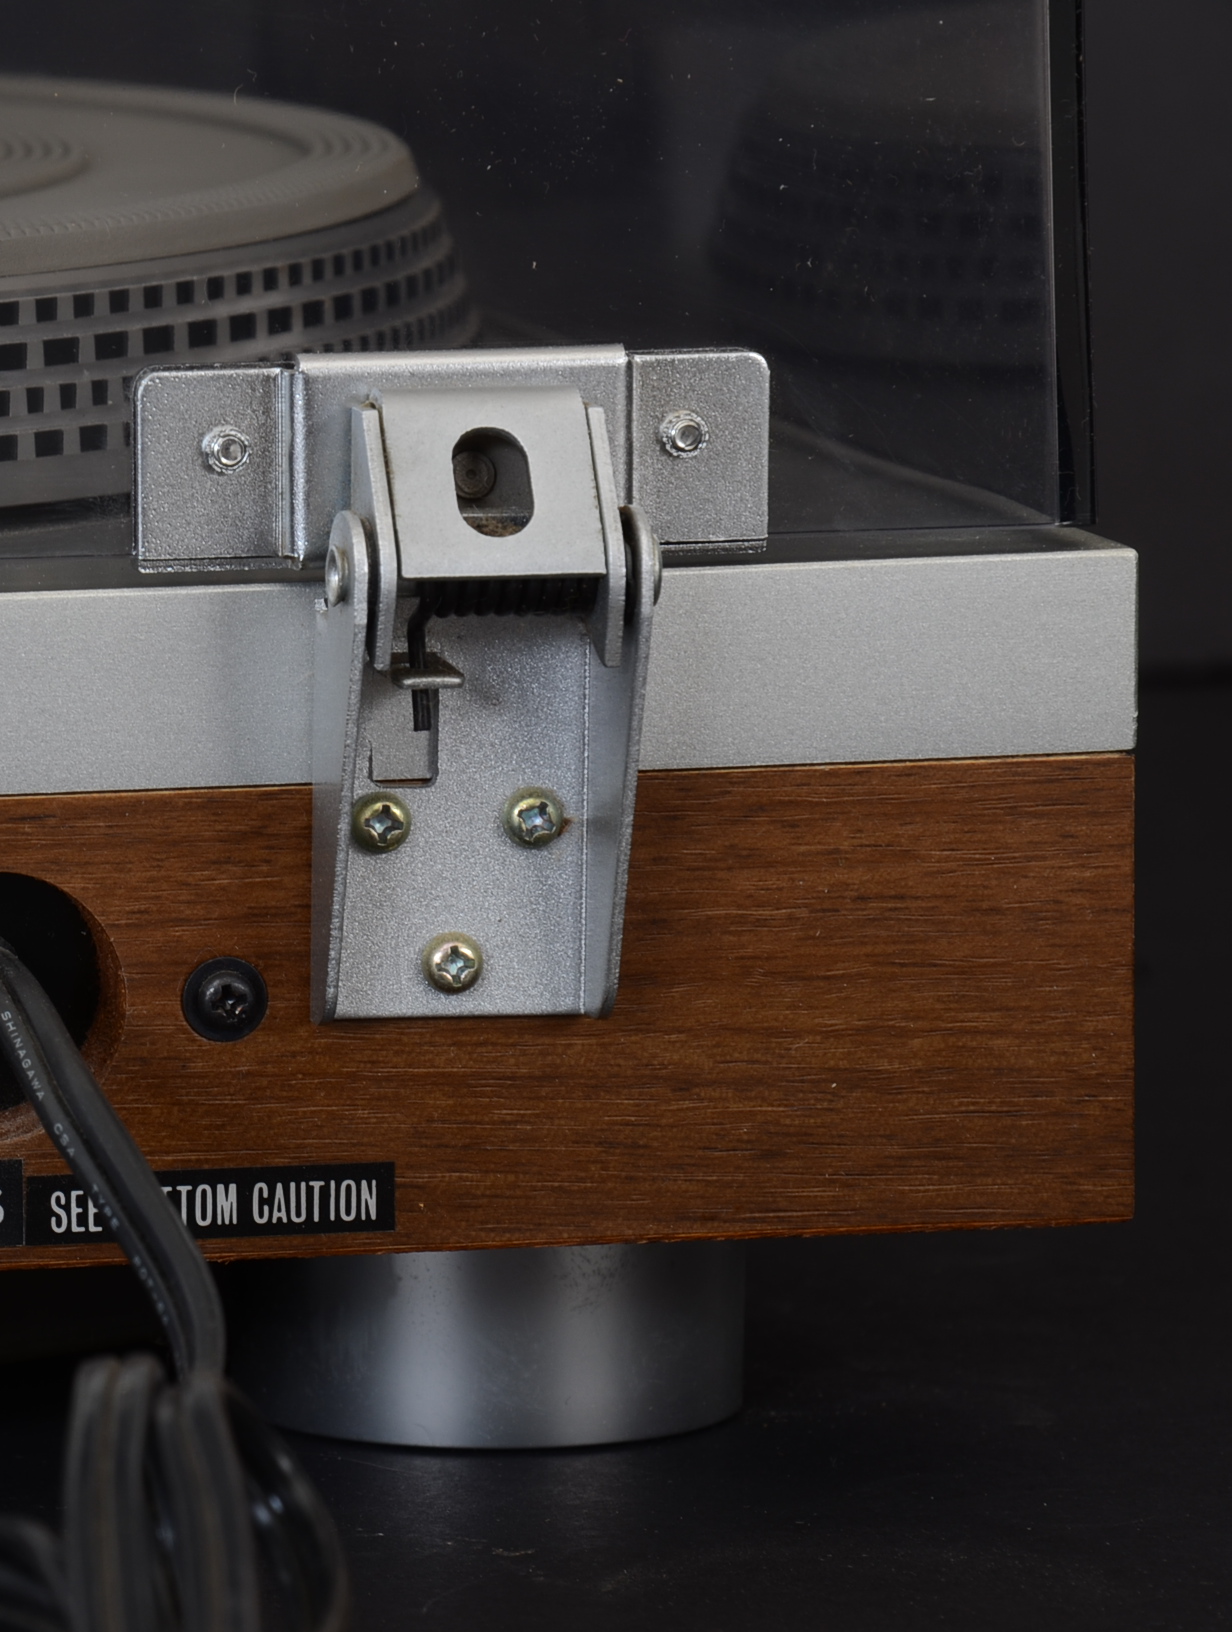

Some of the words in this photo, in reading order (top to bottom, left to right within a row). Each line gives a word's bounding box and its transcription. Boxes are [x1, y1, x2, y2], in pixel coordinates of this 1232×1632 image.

[0, 1010, 46, 1101] SHINAGAWA
[53, 1122, 77, 1159] CSA
[90, 1183, 119, 1231] TYPE
[253, 1180, 376, 1223] CAUTION
